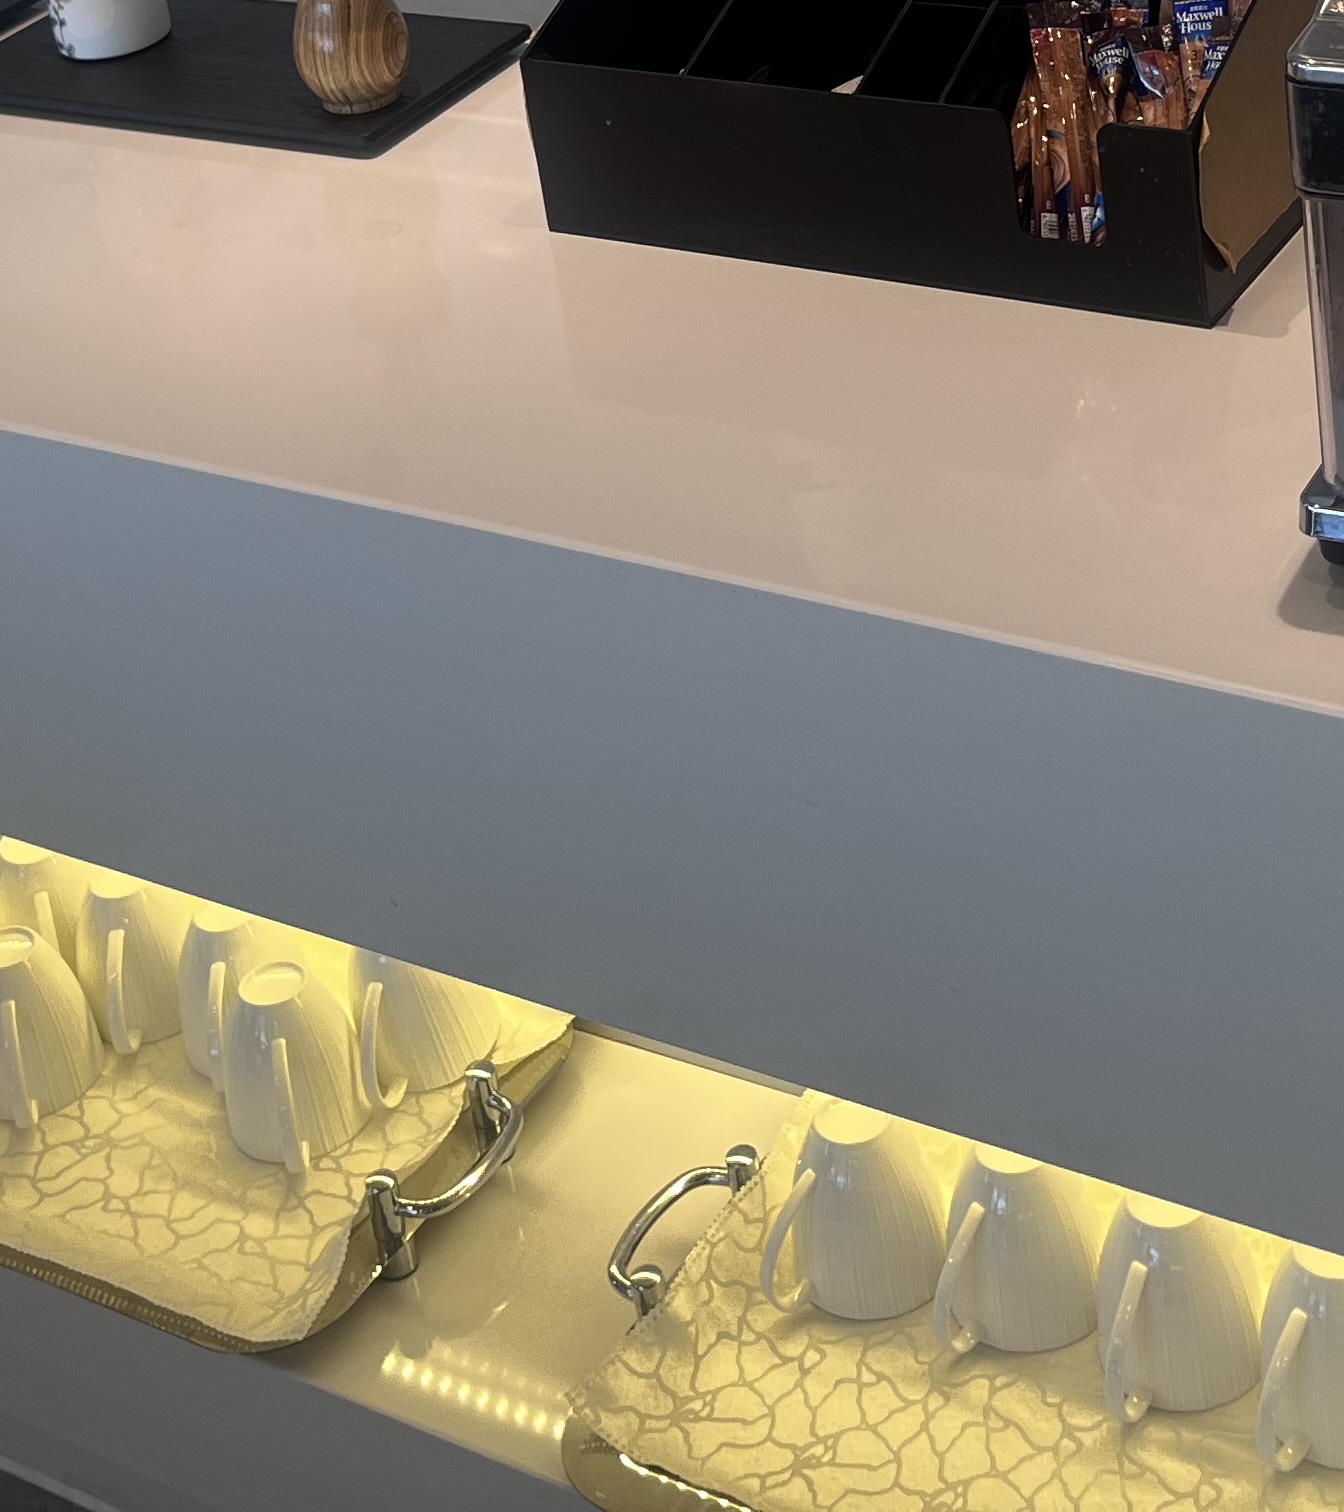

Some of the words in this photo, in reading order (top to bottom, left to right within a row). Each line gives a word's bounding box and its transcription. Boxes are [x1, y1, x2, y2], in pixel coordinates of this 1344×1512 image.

[1176, 6, 1224, 24] Maxwell
[1180, 21, 1213, 35] Hous
[1089, 47, 1130, 68] Maxwell
